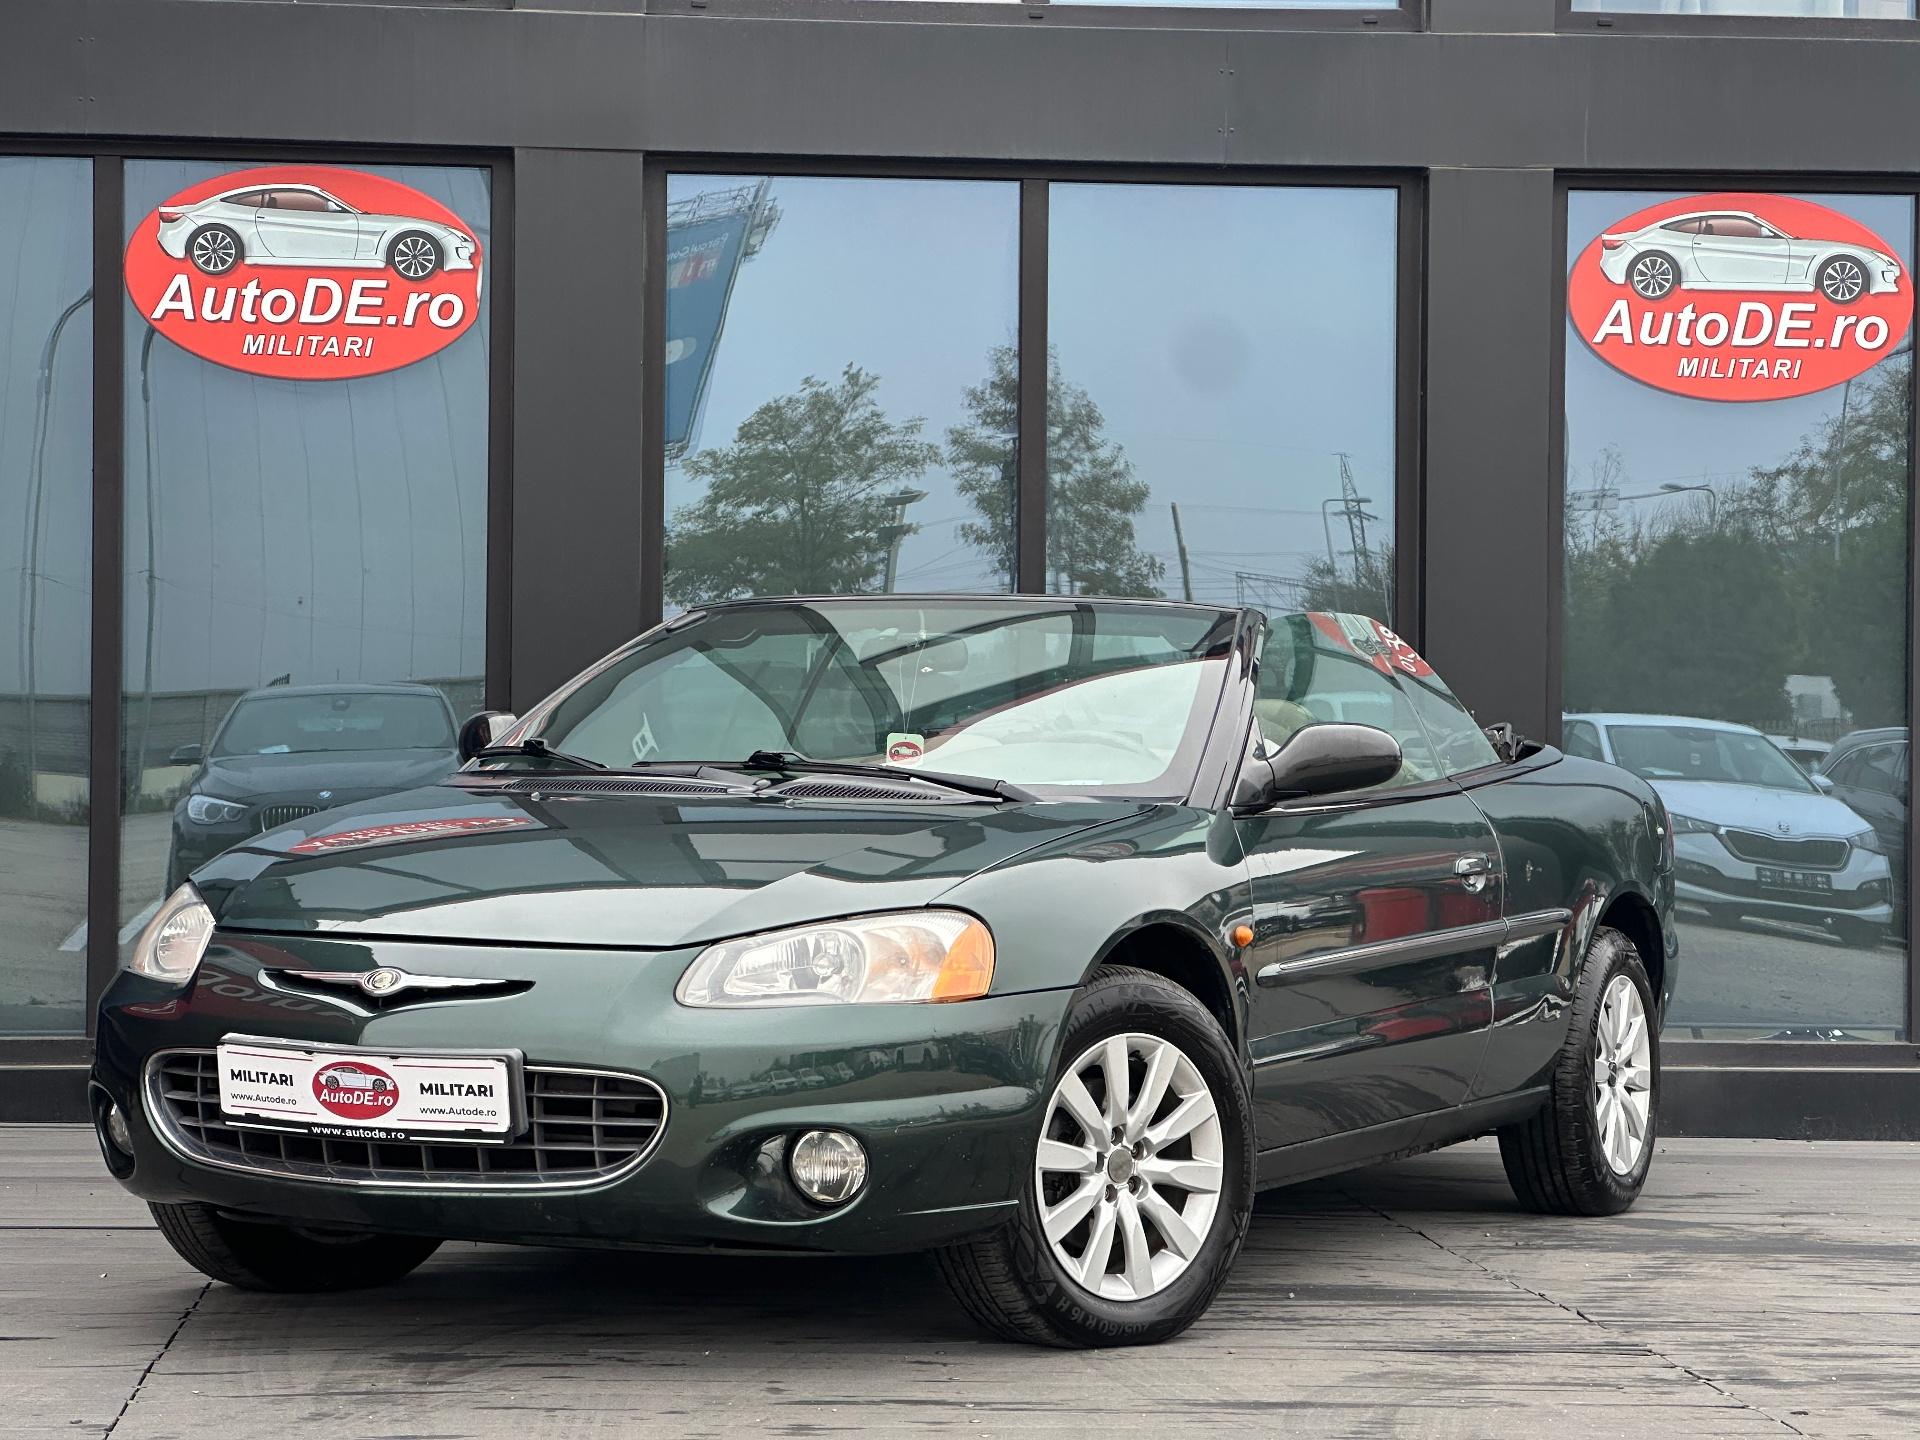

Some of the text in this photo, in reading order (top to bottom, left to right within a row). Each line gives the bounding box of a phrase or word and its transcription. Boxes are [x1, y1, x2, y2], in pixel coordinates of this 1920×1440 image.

[151, 273, 464, 328] AutoDE.ro
[1592, 299, 1889, 350] AutoDE.ro
[242, 334, 374, 358] MILITARI
[1677, 357, 1802, 379] MILITARI
[230, 1068, 294, 1087] MILITARI
[230, 1091, 297, 1106] www.Autode.ro
[319, 1089, 394, 1107] AutoDE.ro
[419, 1082, 494, 1098] MILITARI
[419, 1105, 497, 1117] www.Autode.ro
[311, 1125, 405, 1140] www.autode.ro
